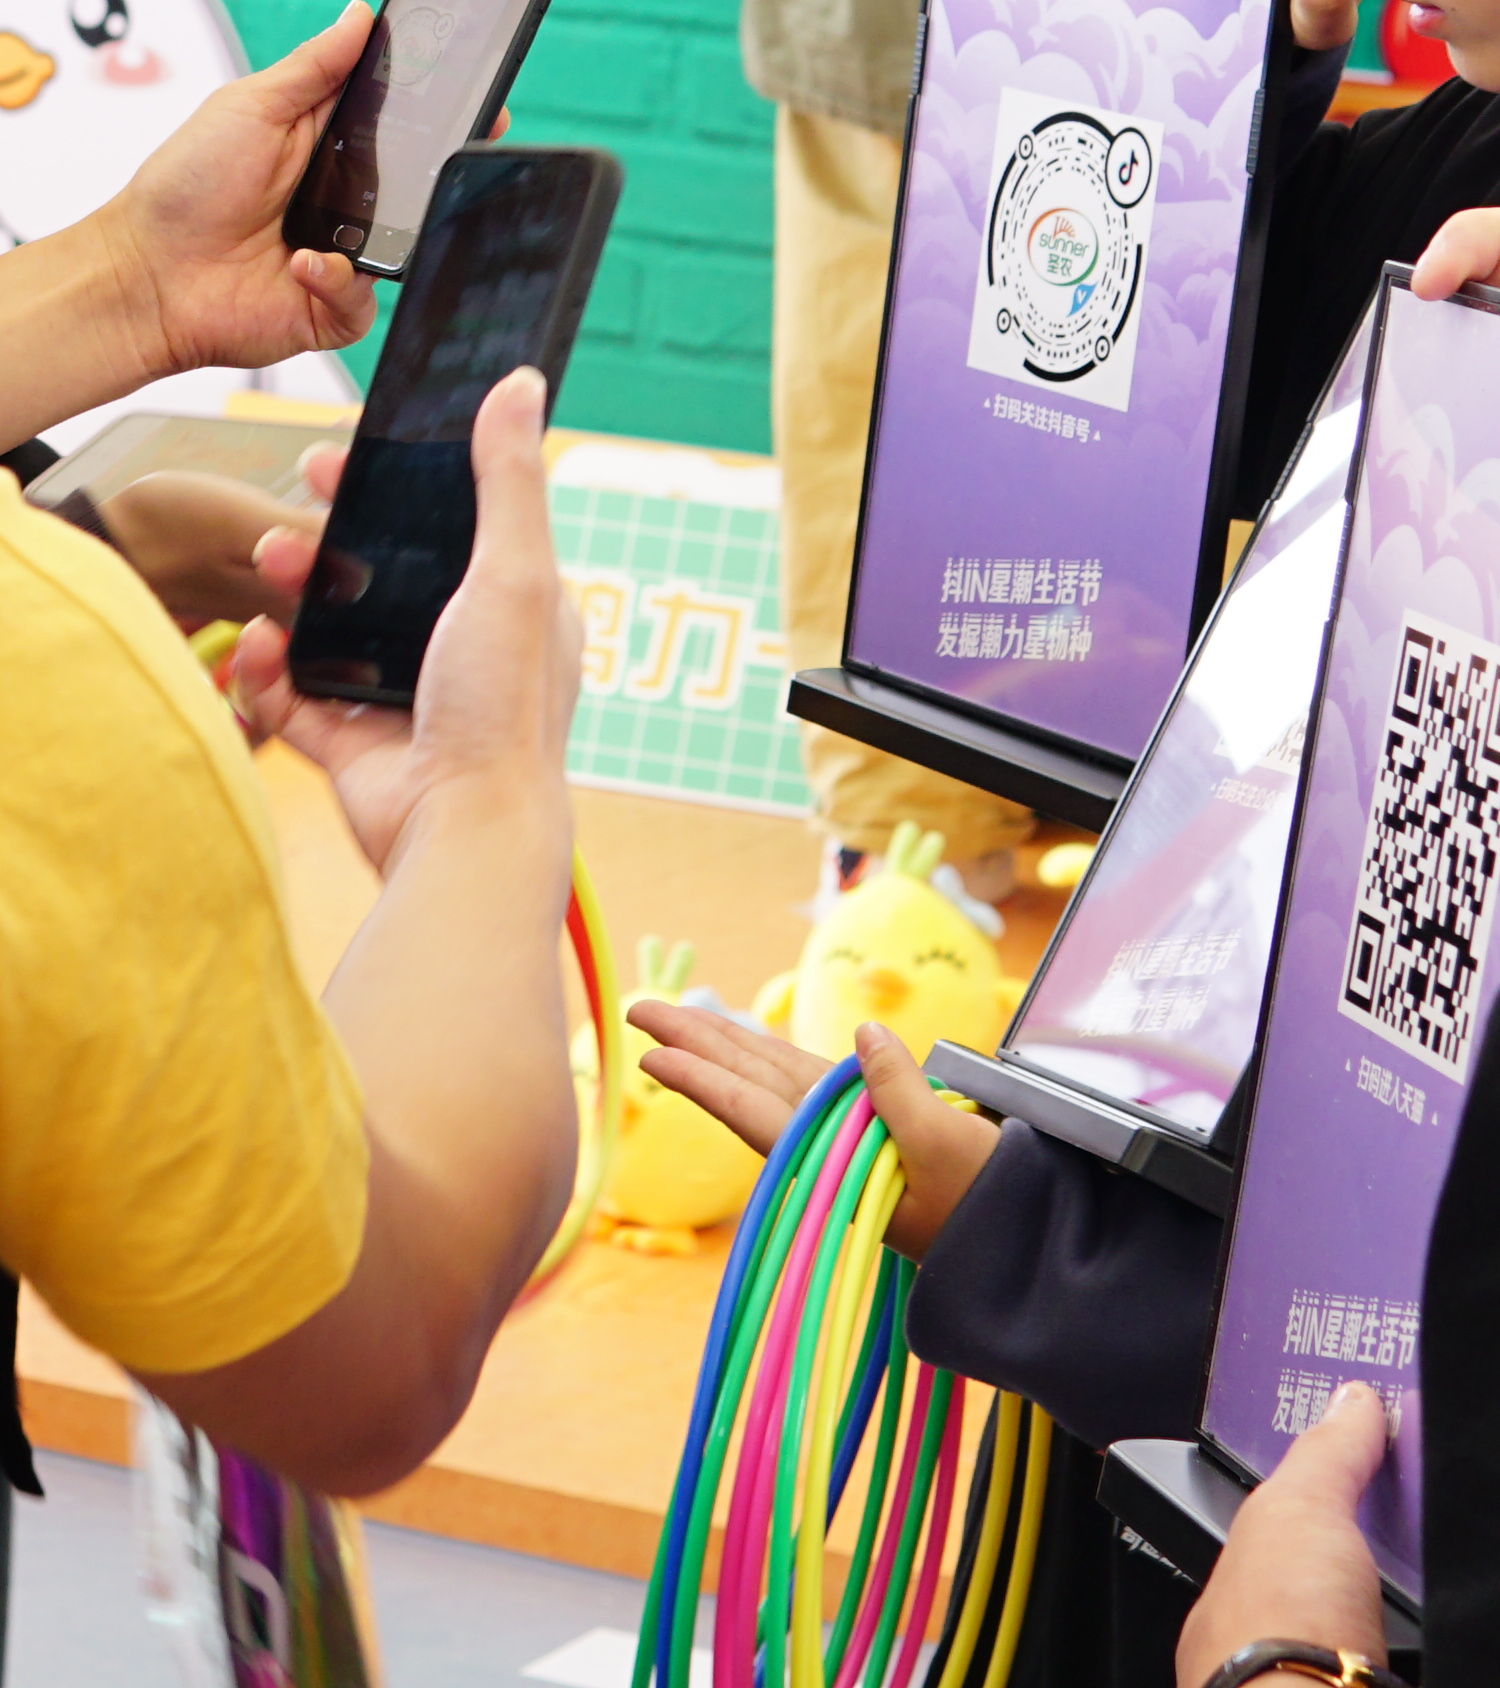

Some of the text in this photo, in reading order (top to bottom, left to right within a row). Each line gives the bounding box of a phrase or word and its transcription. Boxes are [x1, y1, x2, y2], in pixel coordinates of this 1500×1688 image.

[1039, 233, 1089, 258] sunner
[1046, 253, 1073, 277] 圣农
[993, 393, 1091, 443] 扫码关注抖音号
[940, 557, 1103, 607] 抖IN星潮生活节
[935, 611, 1093, 662] 发掘潮力星物种
[1282, 1288, 1421, 1370] 抖IN星潮生活节
[1271, 1368, 1403, 1451] 发掘潮种
